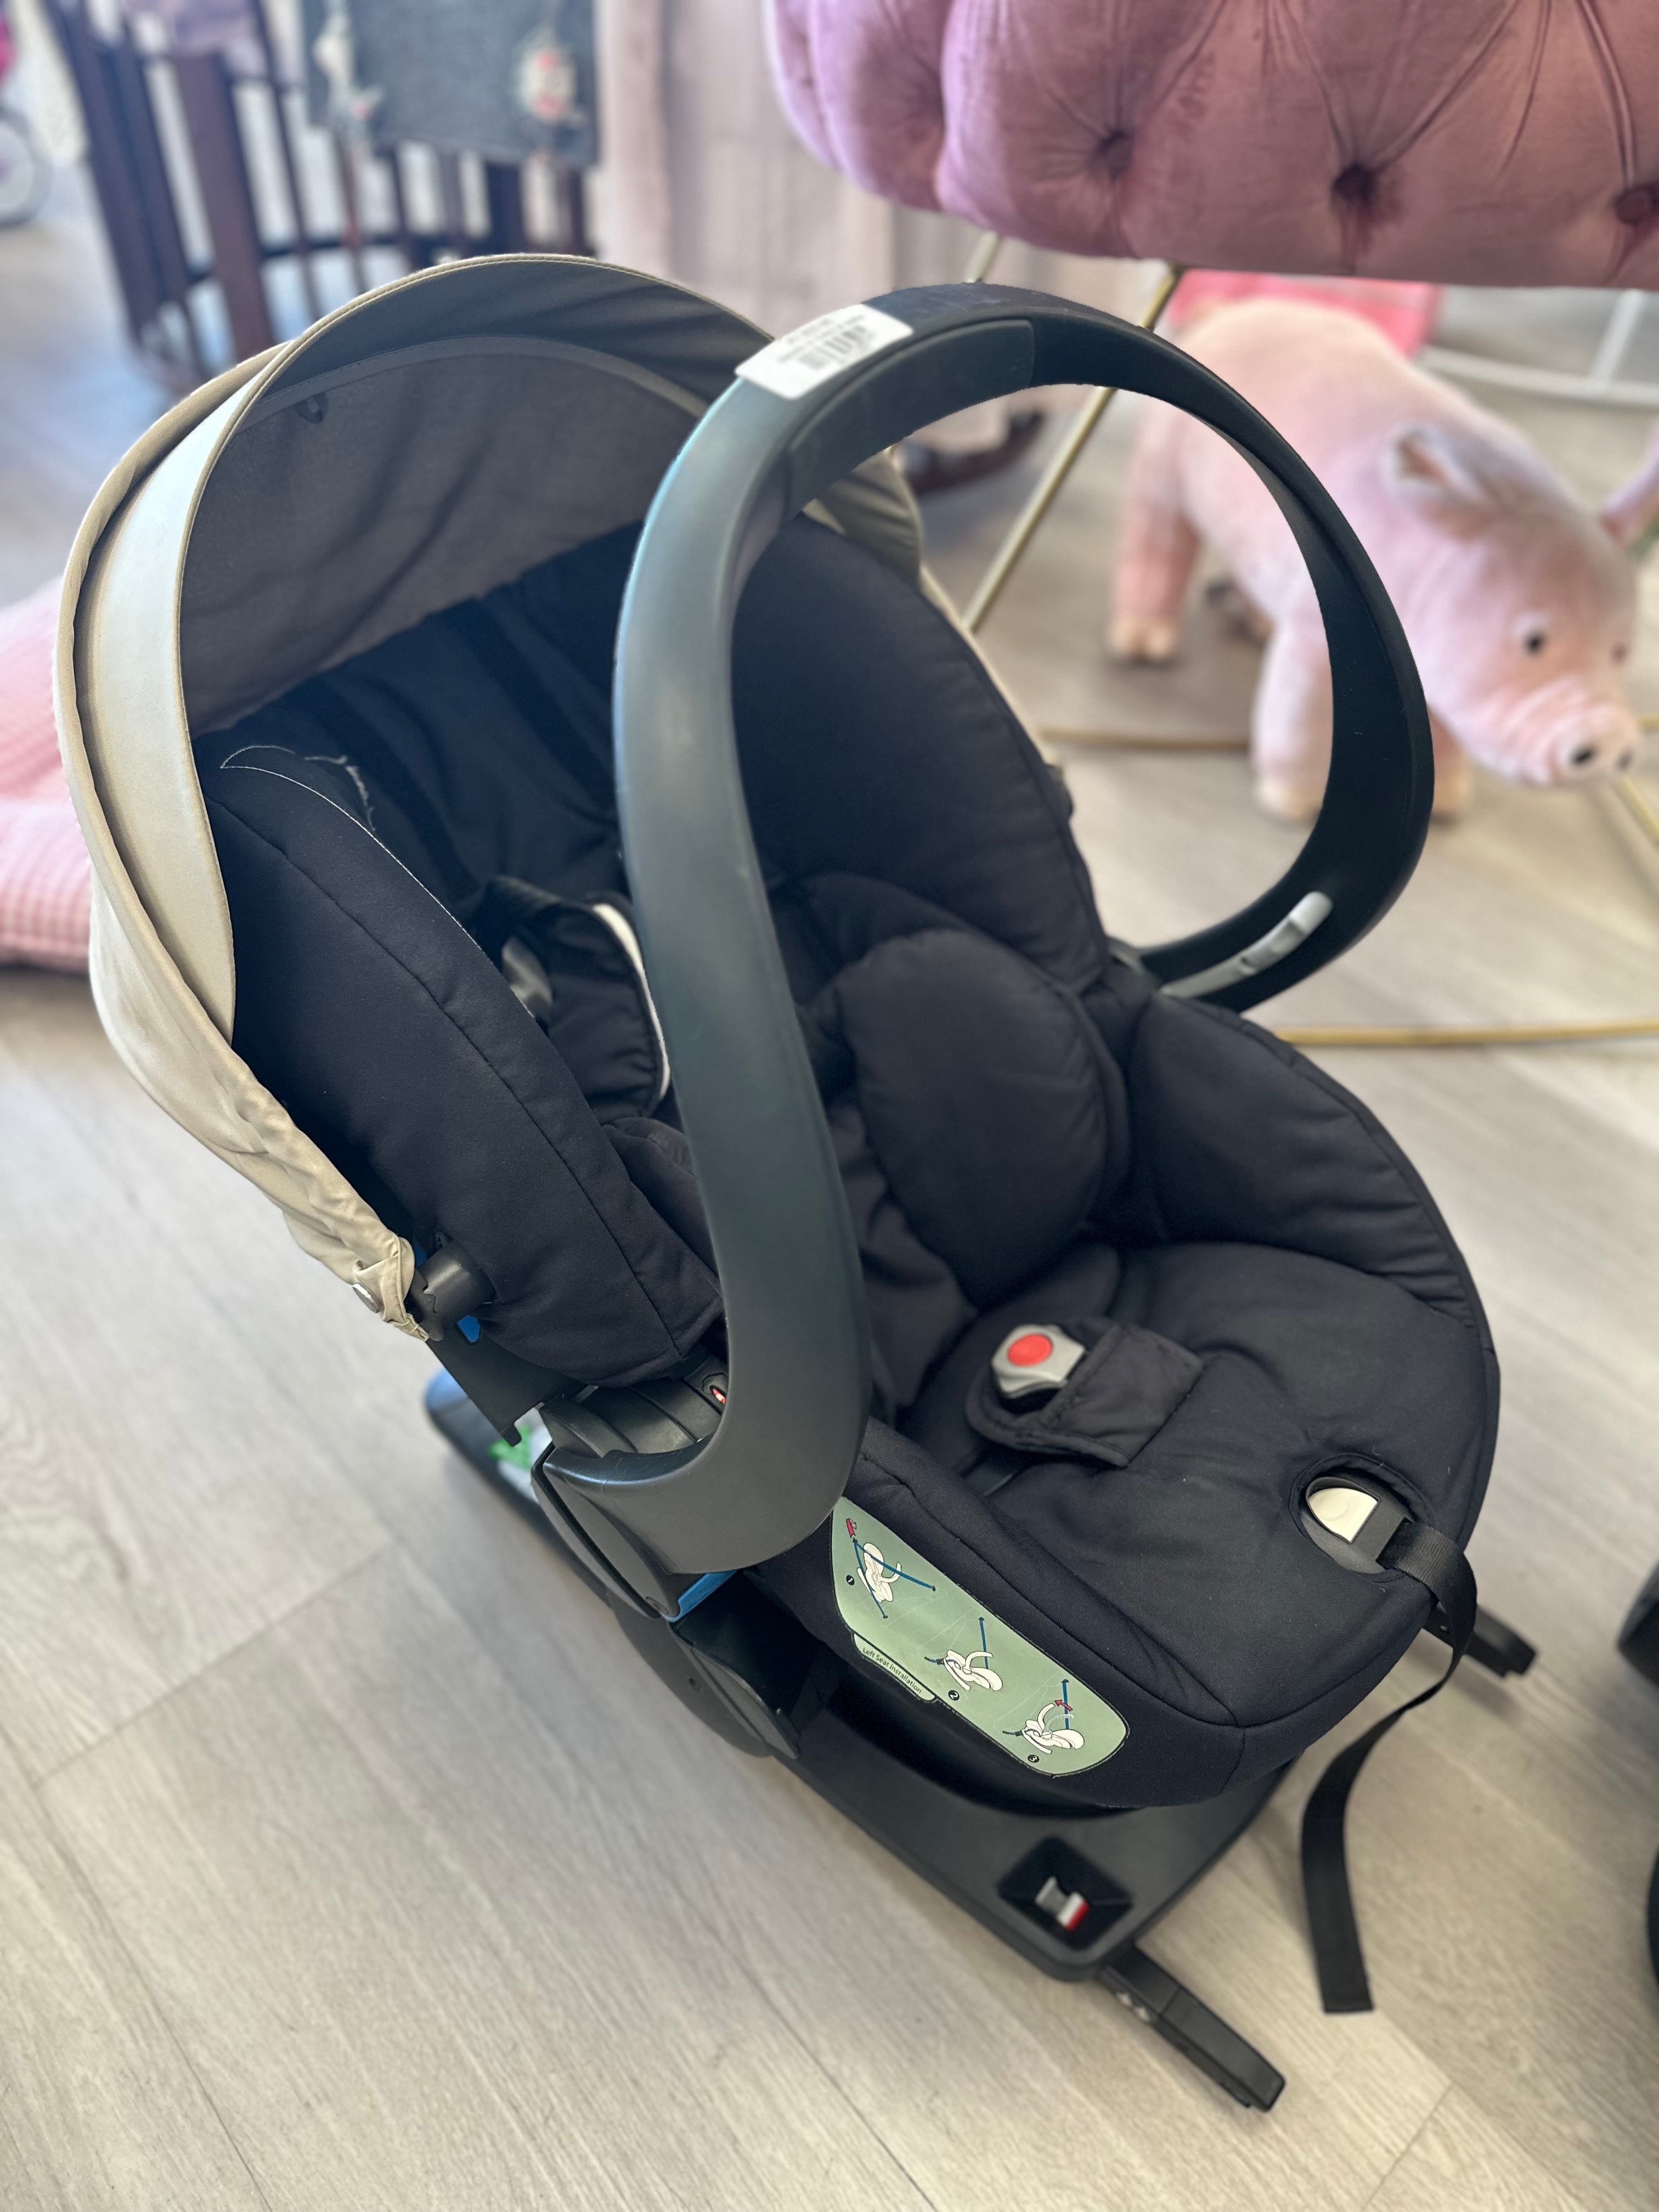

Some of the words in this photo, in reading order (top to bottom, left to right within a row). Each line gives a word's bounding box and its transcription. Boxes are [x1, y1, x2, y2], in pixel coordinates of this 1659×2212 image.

[862, 1647, 875, 1658] Left
[876, 1655, 889, 1667] Seat
[889, 1664, 922, 1694] Installation
